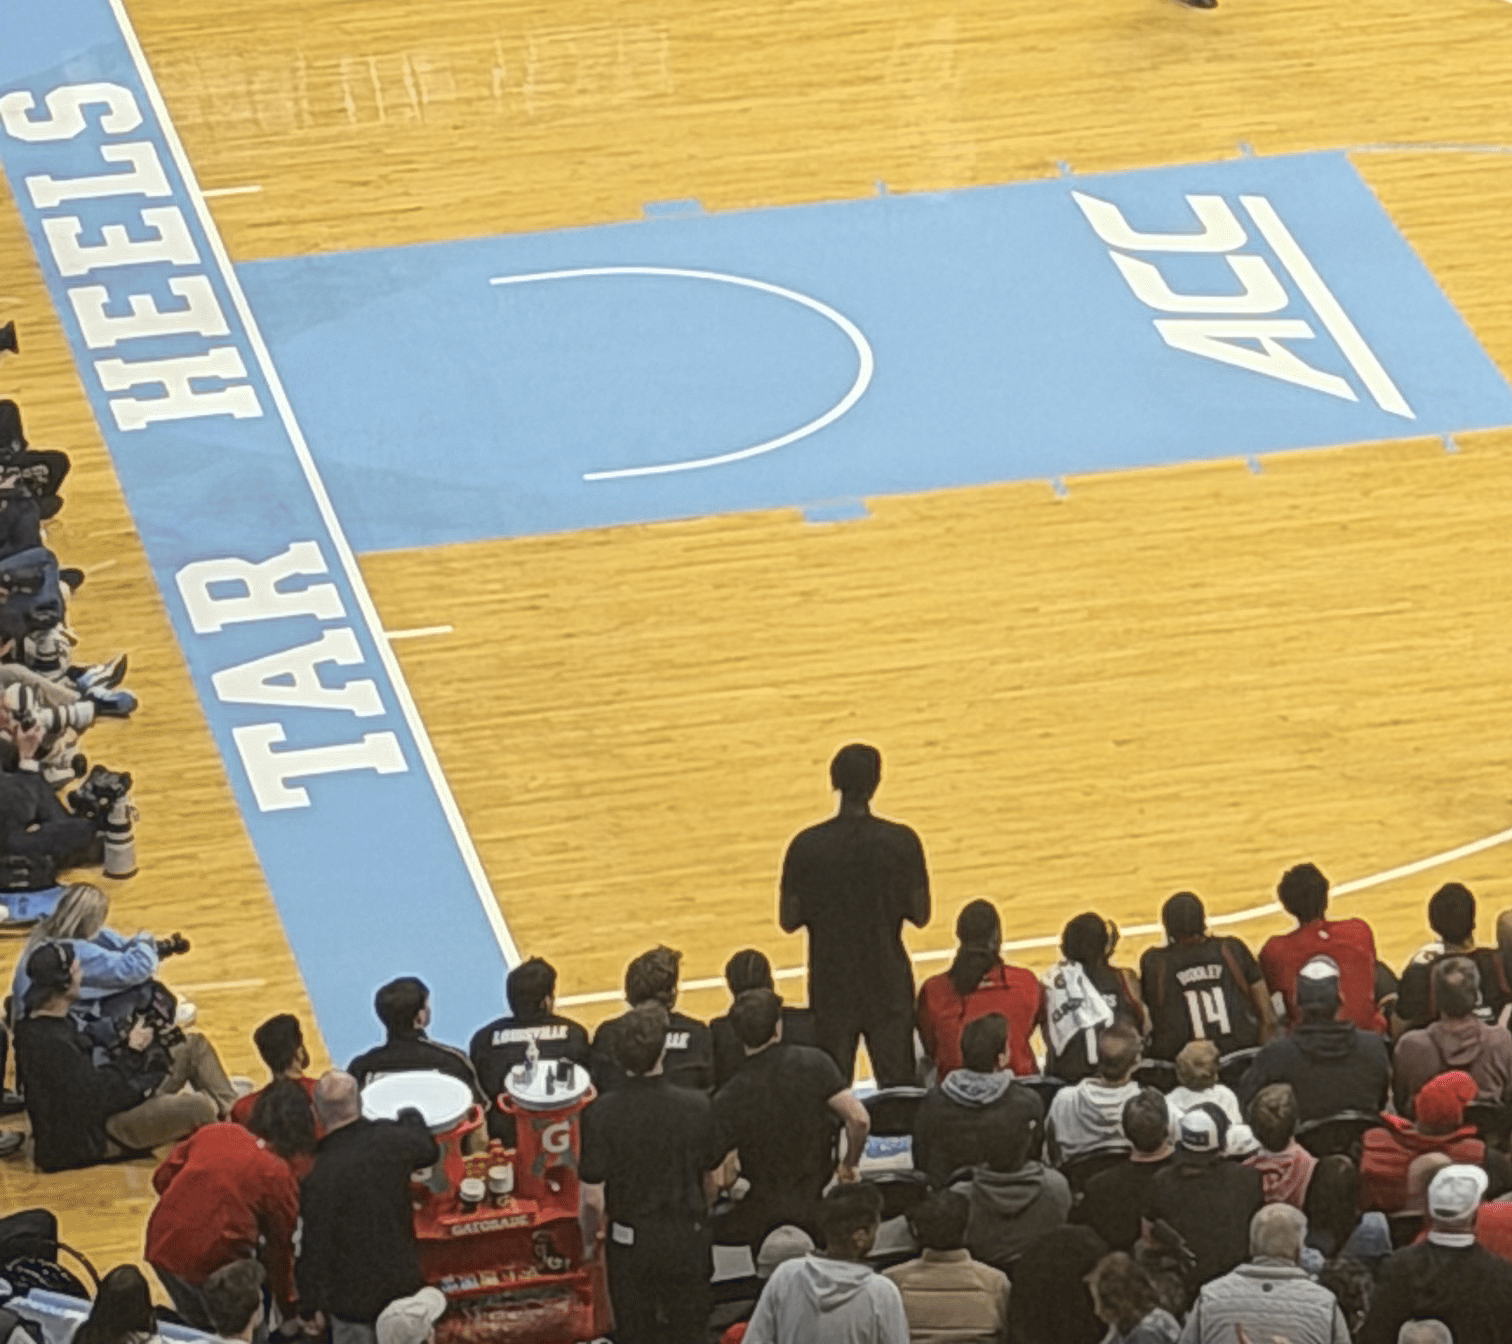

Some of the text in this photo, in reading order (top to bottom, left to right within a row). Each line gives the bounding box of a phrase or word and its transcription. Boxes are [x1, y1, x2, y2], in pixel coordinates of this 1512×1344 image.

[1070, 190, 1361, 403] ACC
[1, 82, 409, 812] TAR HEELS
[1184, 986, 1231, 1039] 14
[492, 1025, 569, 1045] LOUISVILLE
[541, 1120, 571, 1153] G
[451, 1214, 529, 1236] GATORADE
